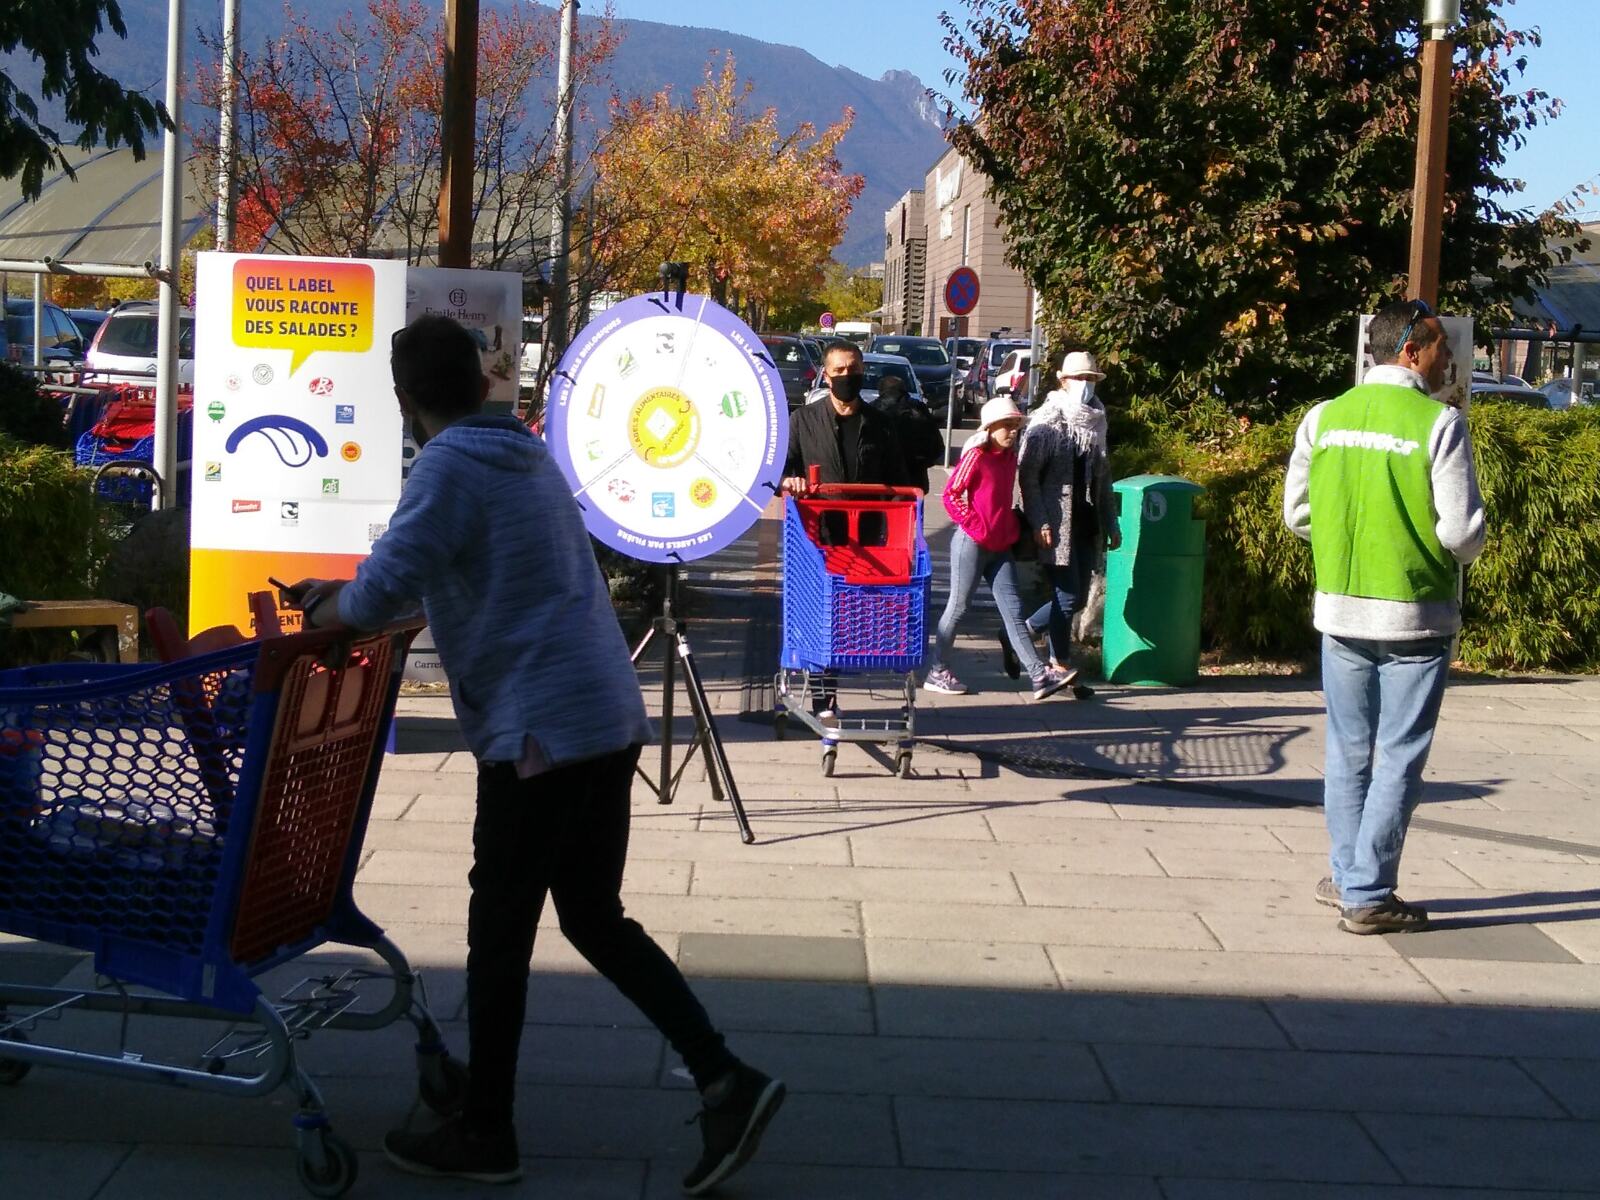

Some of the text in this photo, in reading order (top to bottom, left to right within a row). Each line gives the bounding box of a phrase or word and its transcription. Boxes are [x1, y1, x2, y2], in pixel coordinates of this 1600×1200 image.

[246, 276, 335, 293] QUEL LABEL
[246, 298, 358, 316] VOUS RACONTE
[245, 320, 358, 337] DES SALADES ?
[730, 330, 745, 345] LES
[761, 374, 778, 466] ENVIRONNEMENTAUX
[647, 540, 664, 549] PAR
[666, 538, 697, 549] LABELS
[697, 532, 713, 544] LES
